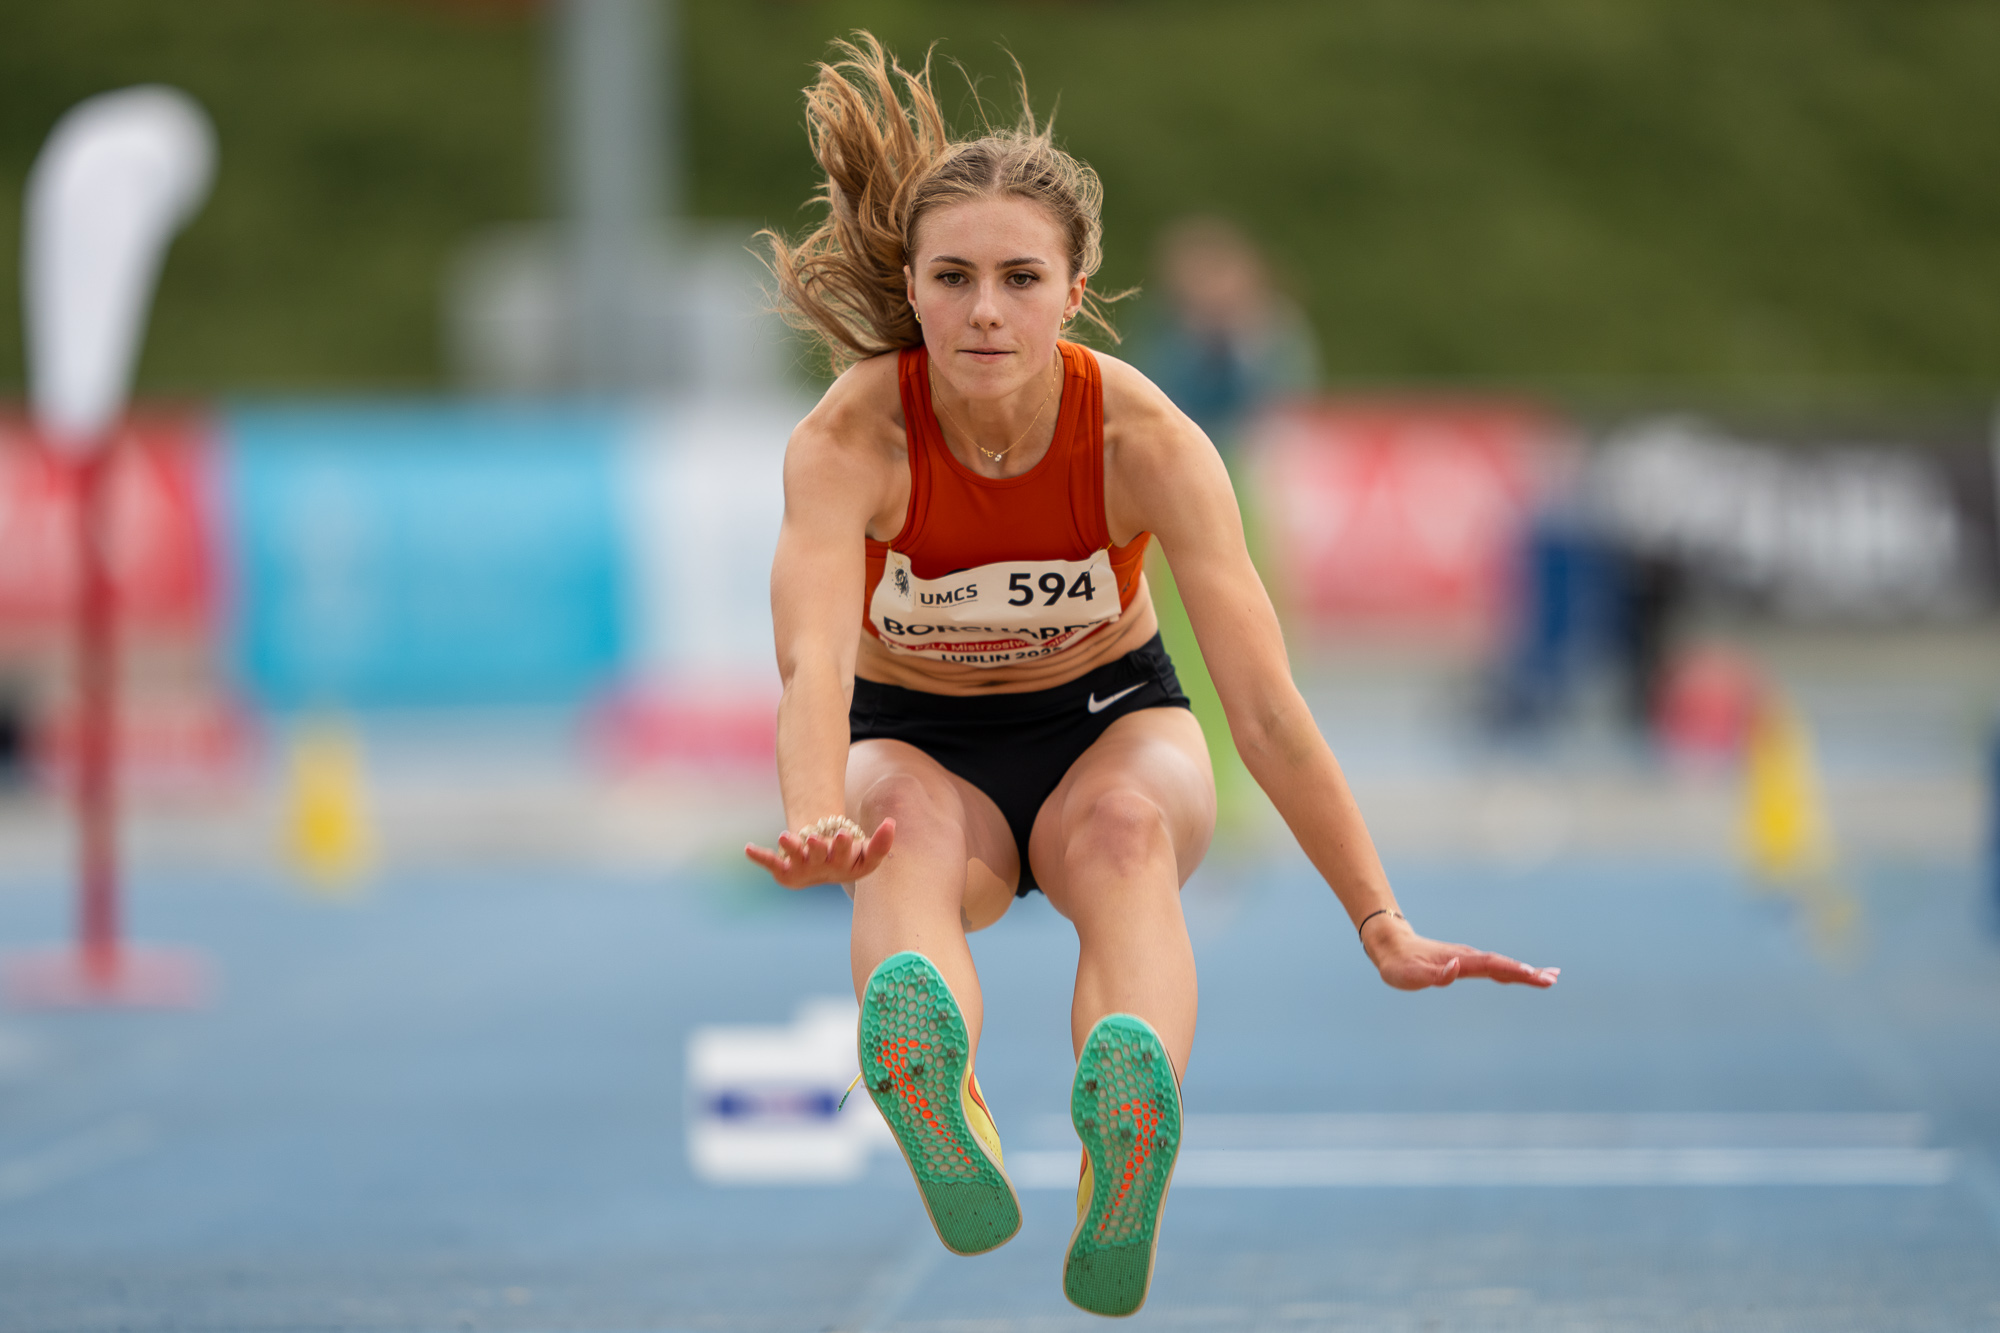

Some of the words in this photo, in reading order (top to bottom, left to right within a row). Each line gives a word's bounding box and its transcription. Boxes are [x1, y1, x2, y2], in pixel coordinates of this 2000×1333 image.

[920, 583, 978, 605] UMCS
[1007, 571, 1096, 607] 594
[941, 653, 1010, 664] LUBLIN
